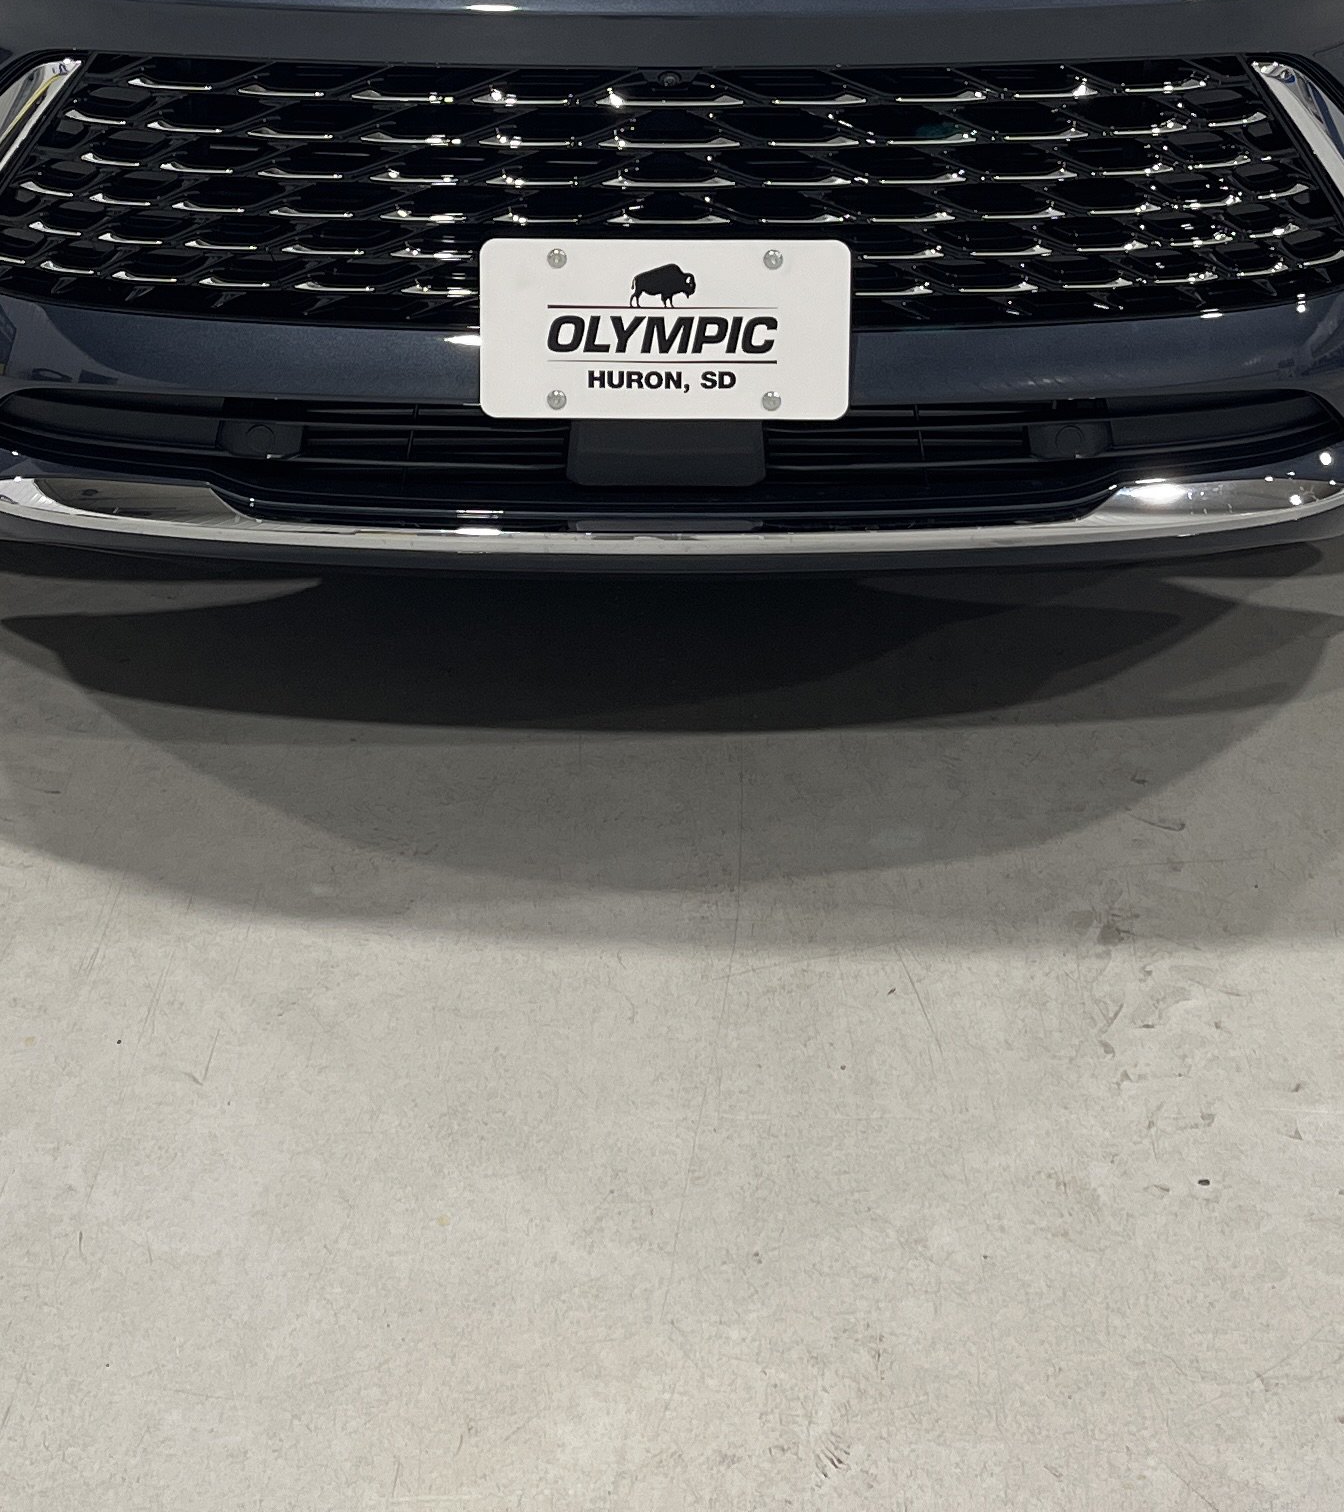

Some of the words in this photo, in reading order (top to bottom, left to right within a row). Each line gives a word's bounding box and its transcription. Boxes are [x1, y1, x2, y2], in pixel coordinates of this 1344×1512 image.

[547, 315, 778, 354] OLYMPIC
[588, 370, 690, 393] HURON,
[700, 370, 737, 389] SD
